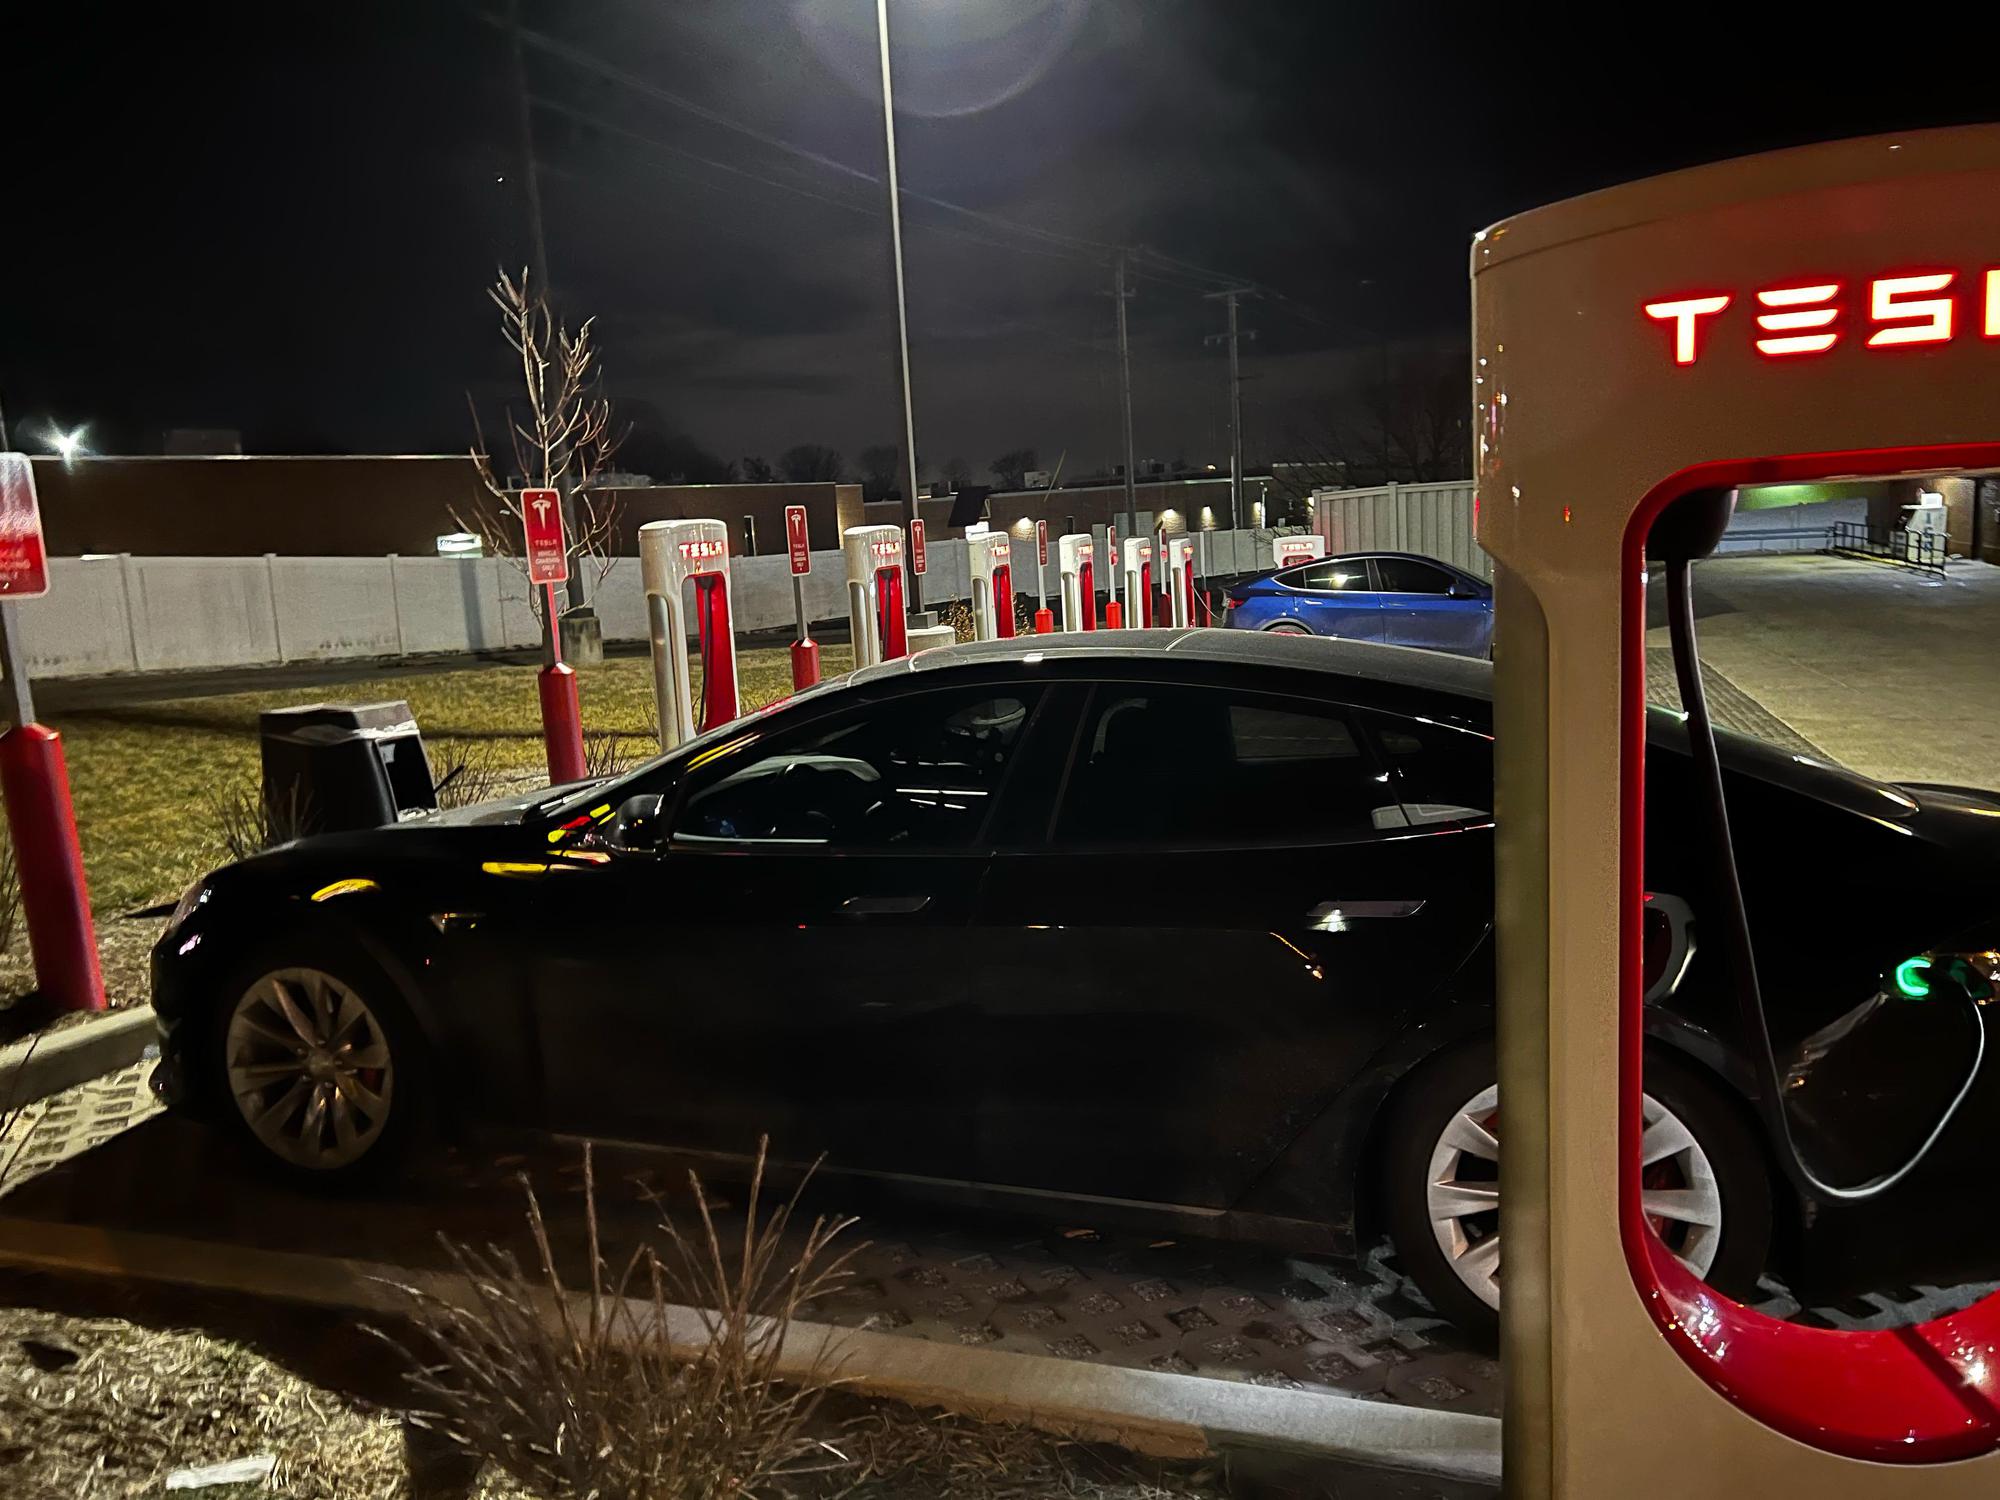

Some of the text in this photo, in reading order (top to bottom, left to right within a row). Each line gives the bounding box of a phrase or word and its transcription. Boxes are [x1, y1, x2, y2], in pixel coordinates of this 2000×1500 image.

[1645, 267, 2000, 365] TES
[678, 541, 723, 560] TESLA
[871, 541, 900, 556] TESLA
[1281, 543, 1313, 552] TESLA
